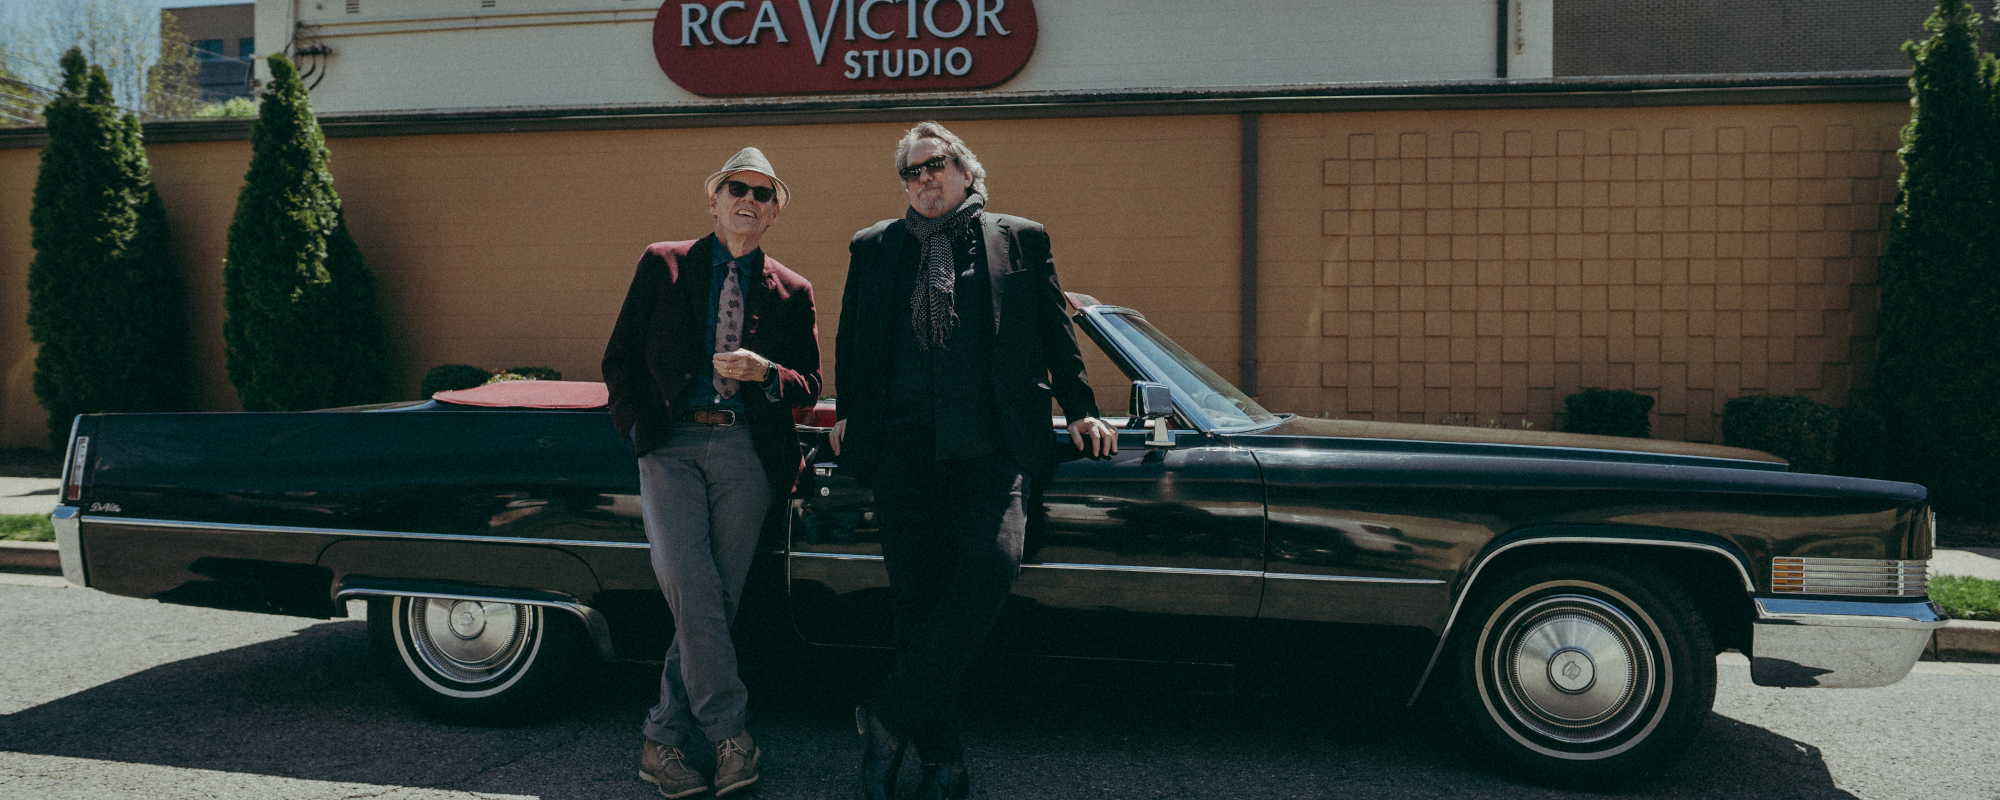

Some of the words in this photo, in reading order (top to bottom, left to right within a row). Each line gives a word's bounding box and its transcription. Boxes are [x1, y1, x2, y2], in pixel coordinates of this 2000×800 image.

[680, 0, 789, 47] RCA
[798, 0, 1011, 66] VICTOR
[843, 46, 973, 80] STUDIO
